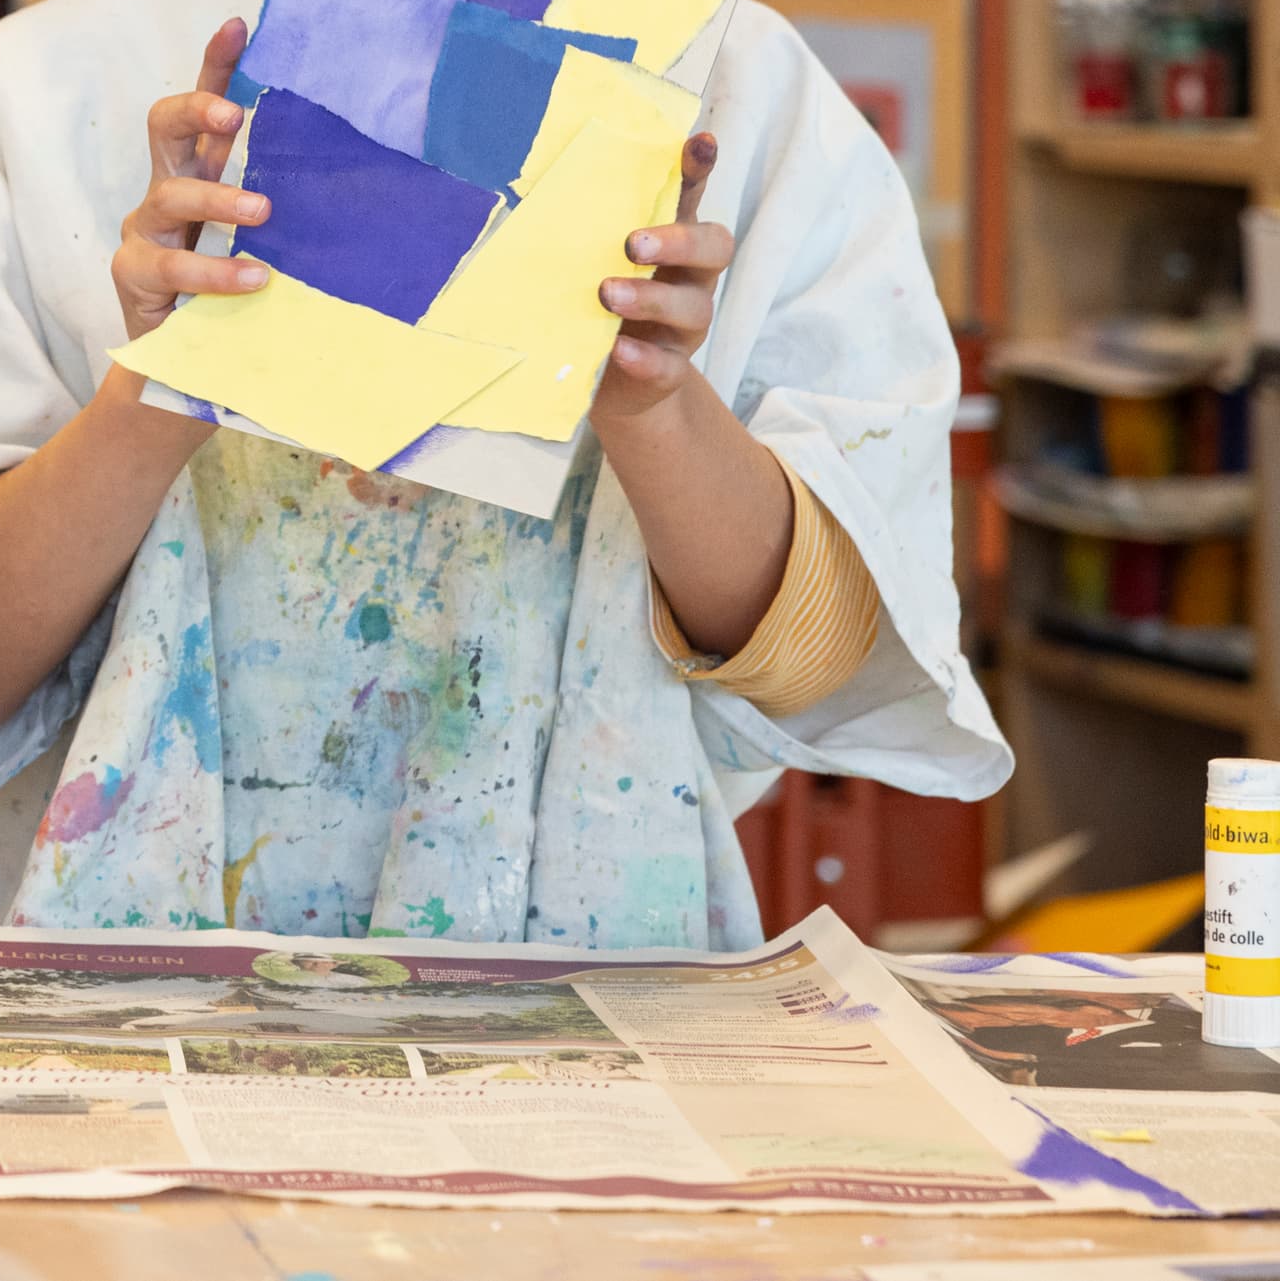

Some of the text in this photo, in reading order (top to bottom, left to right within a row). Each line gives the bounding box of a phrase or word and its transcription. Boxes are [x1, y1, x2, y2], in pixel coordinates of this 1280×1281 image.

[1212, 928, 1225, 943] de
[1230, 930, 1265, 945] colle
[97, 954, 185, 966] QUEEN
